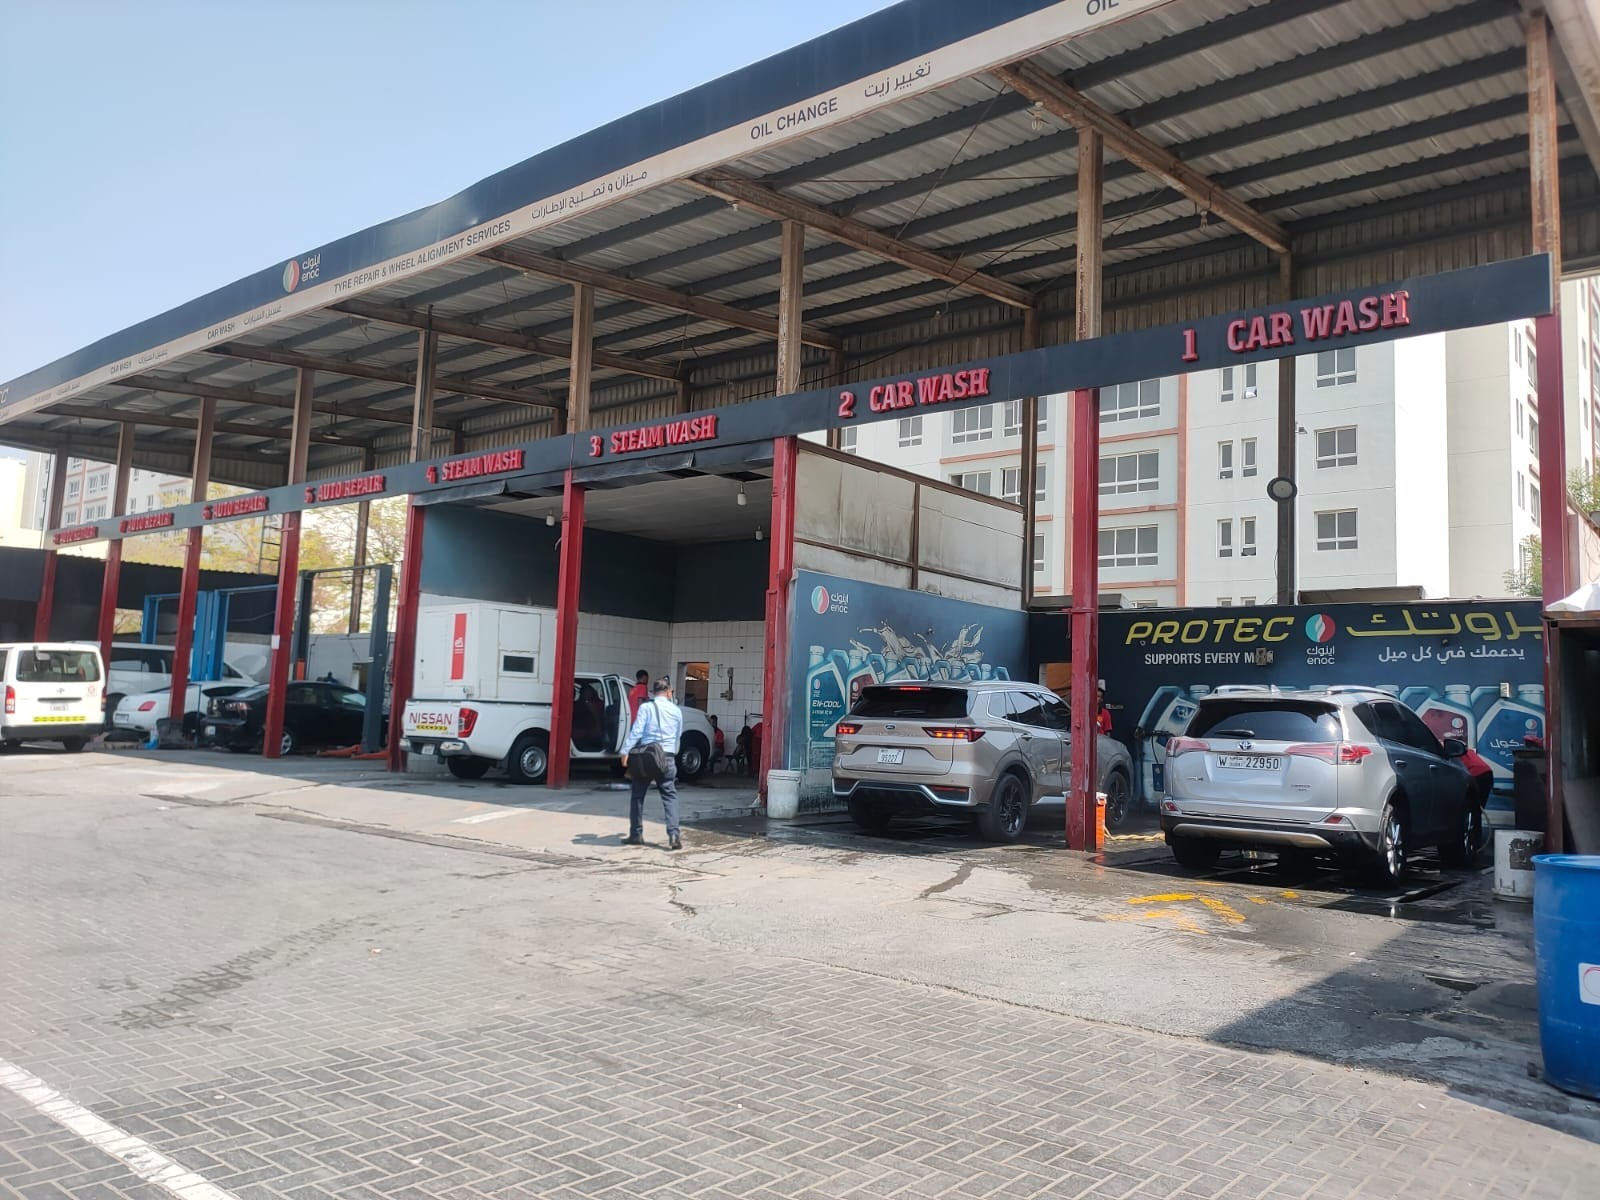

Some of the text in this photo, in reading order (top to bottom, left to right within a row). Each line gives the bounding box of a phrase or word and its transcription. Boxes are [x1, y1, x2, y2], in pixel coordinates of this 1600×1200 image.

[864, 61, 931, 98] تغيير زيت
[750, 97, 838, 140] OIL CHANGE
[615, 170, 647, 190] ميزان
[334, 219, 511, 294] TYRE REPAIR & WHEEL ALIGNMENT SERVICES
[302, 267, 320, 282] enoc
[207, 322, 235, 339] CAR WASH
[1182, 290, 1410, 361] 1 CAR WASH
[838, 367, 990, 418] 2 CAR WASH
[589, 414, 718, 457] 3 STEAM WASH
[426, 449, 523, 484] 4 STEAM WASH
[318, 481, 344, 501] AUTO
[343, 475, 384, 496] REPAIR
[213, 502, 234, 518] AUTO
[234, 495, 267, 513] REPAIR
[830, 604, 848, 614] enoc
[1125, 616, 1295, 645] PROTEC
[1144, 652, 1201, 665] SUPPORTS
[1204, 652, 1241, 664] EVERY
[1306, 645, 1335, 657] اينوك
[1306, 657, 1336, 665] enoc
[1378, 645, 1525, 665] يدعمك في كل ميل
[409, 712, 453, 725] NISSAN
[1219, 756, 1227, 767] W
[1246, 757, 1279, 770] 22950
